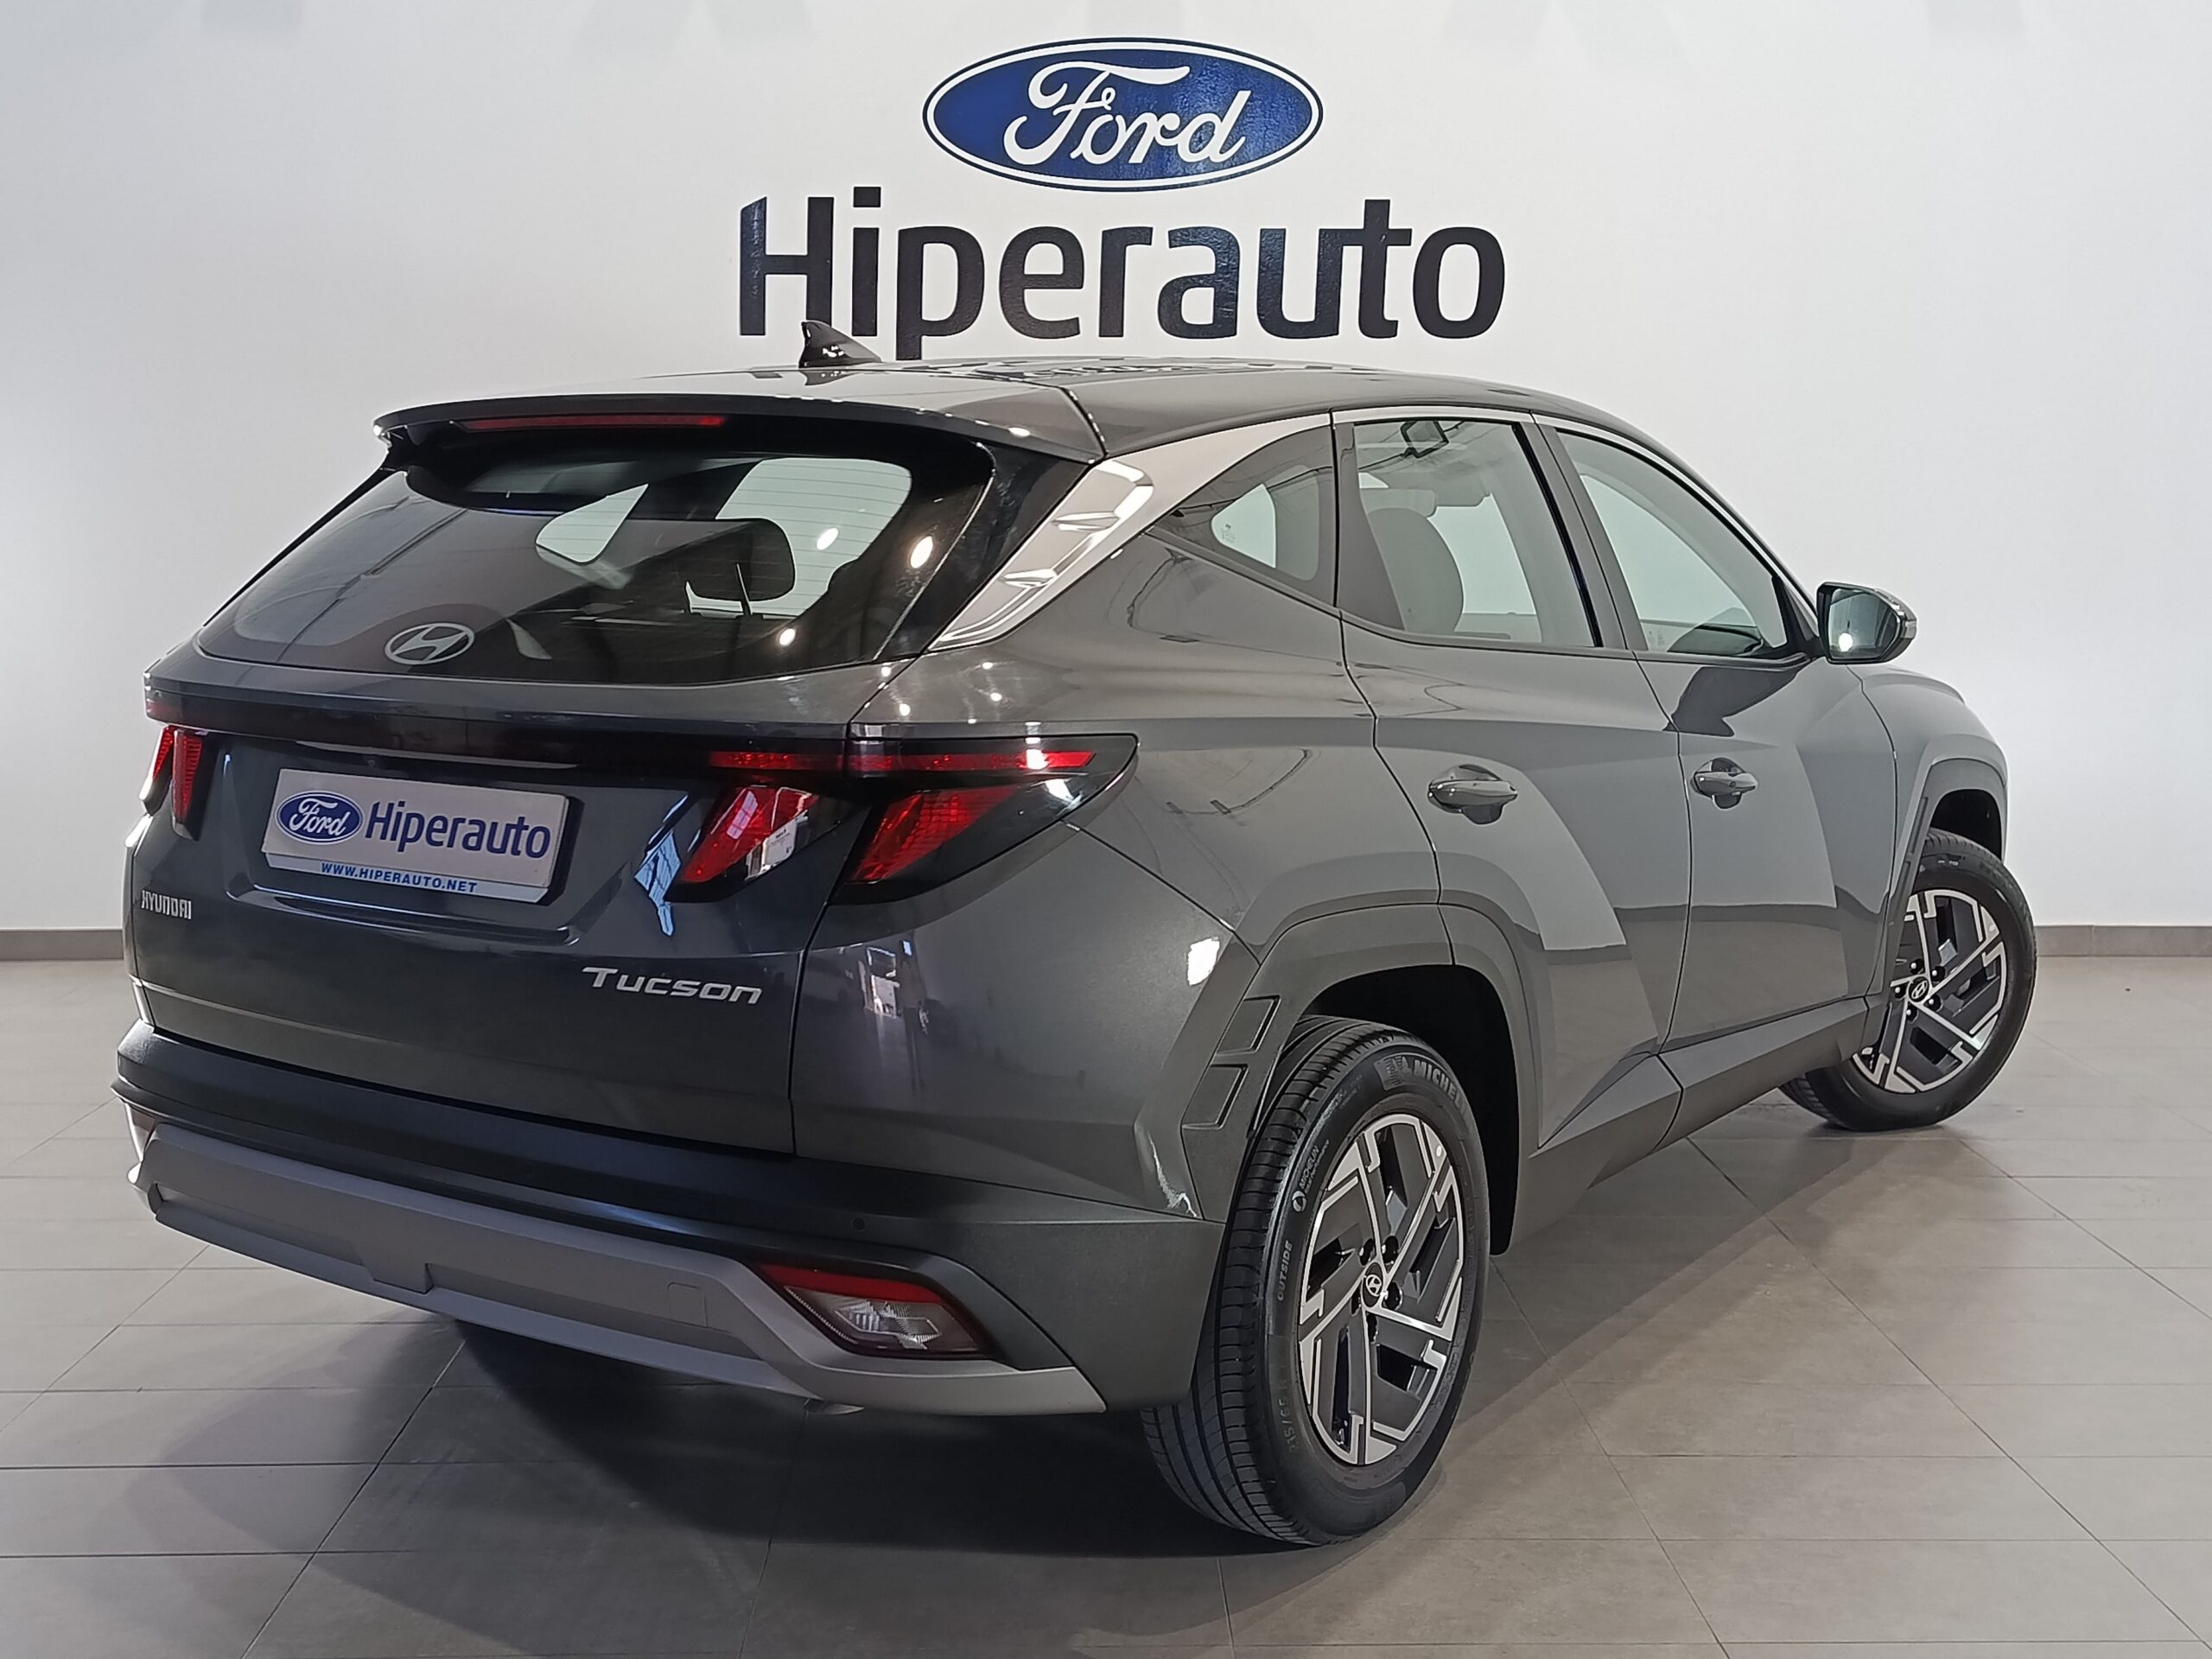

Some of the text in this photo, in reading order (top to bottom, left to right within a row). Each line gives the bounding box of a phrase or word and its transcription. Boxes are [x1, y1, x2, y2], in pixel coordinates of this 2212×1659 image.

[1004, 61, 1251, 165] Ford
[740, 187, 1506, 360] Hiperauto
[288, 797, 352, 837] Ford
[364, 800, 551, 859] Hiperauto
[141, 889, 192, 920] HYUNDAI
[321, 861, 478, 893] WWW.HIPERAUTO.NET
[1413, 1058, 1468, 1116] MICHELI
[1277, 1239, 1293, 1301] OUTSIDE
